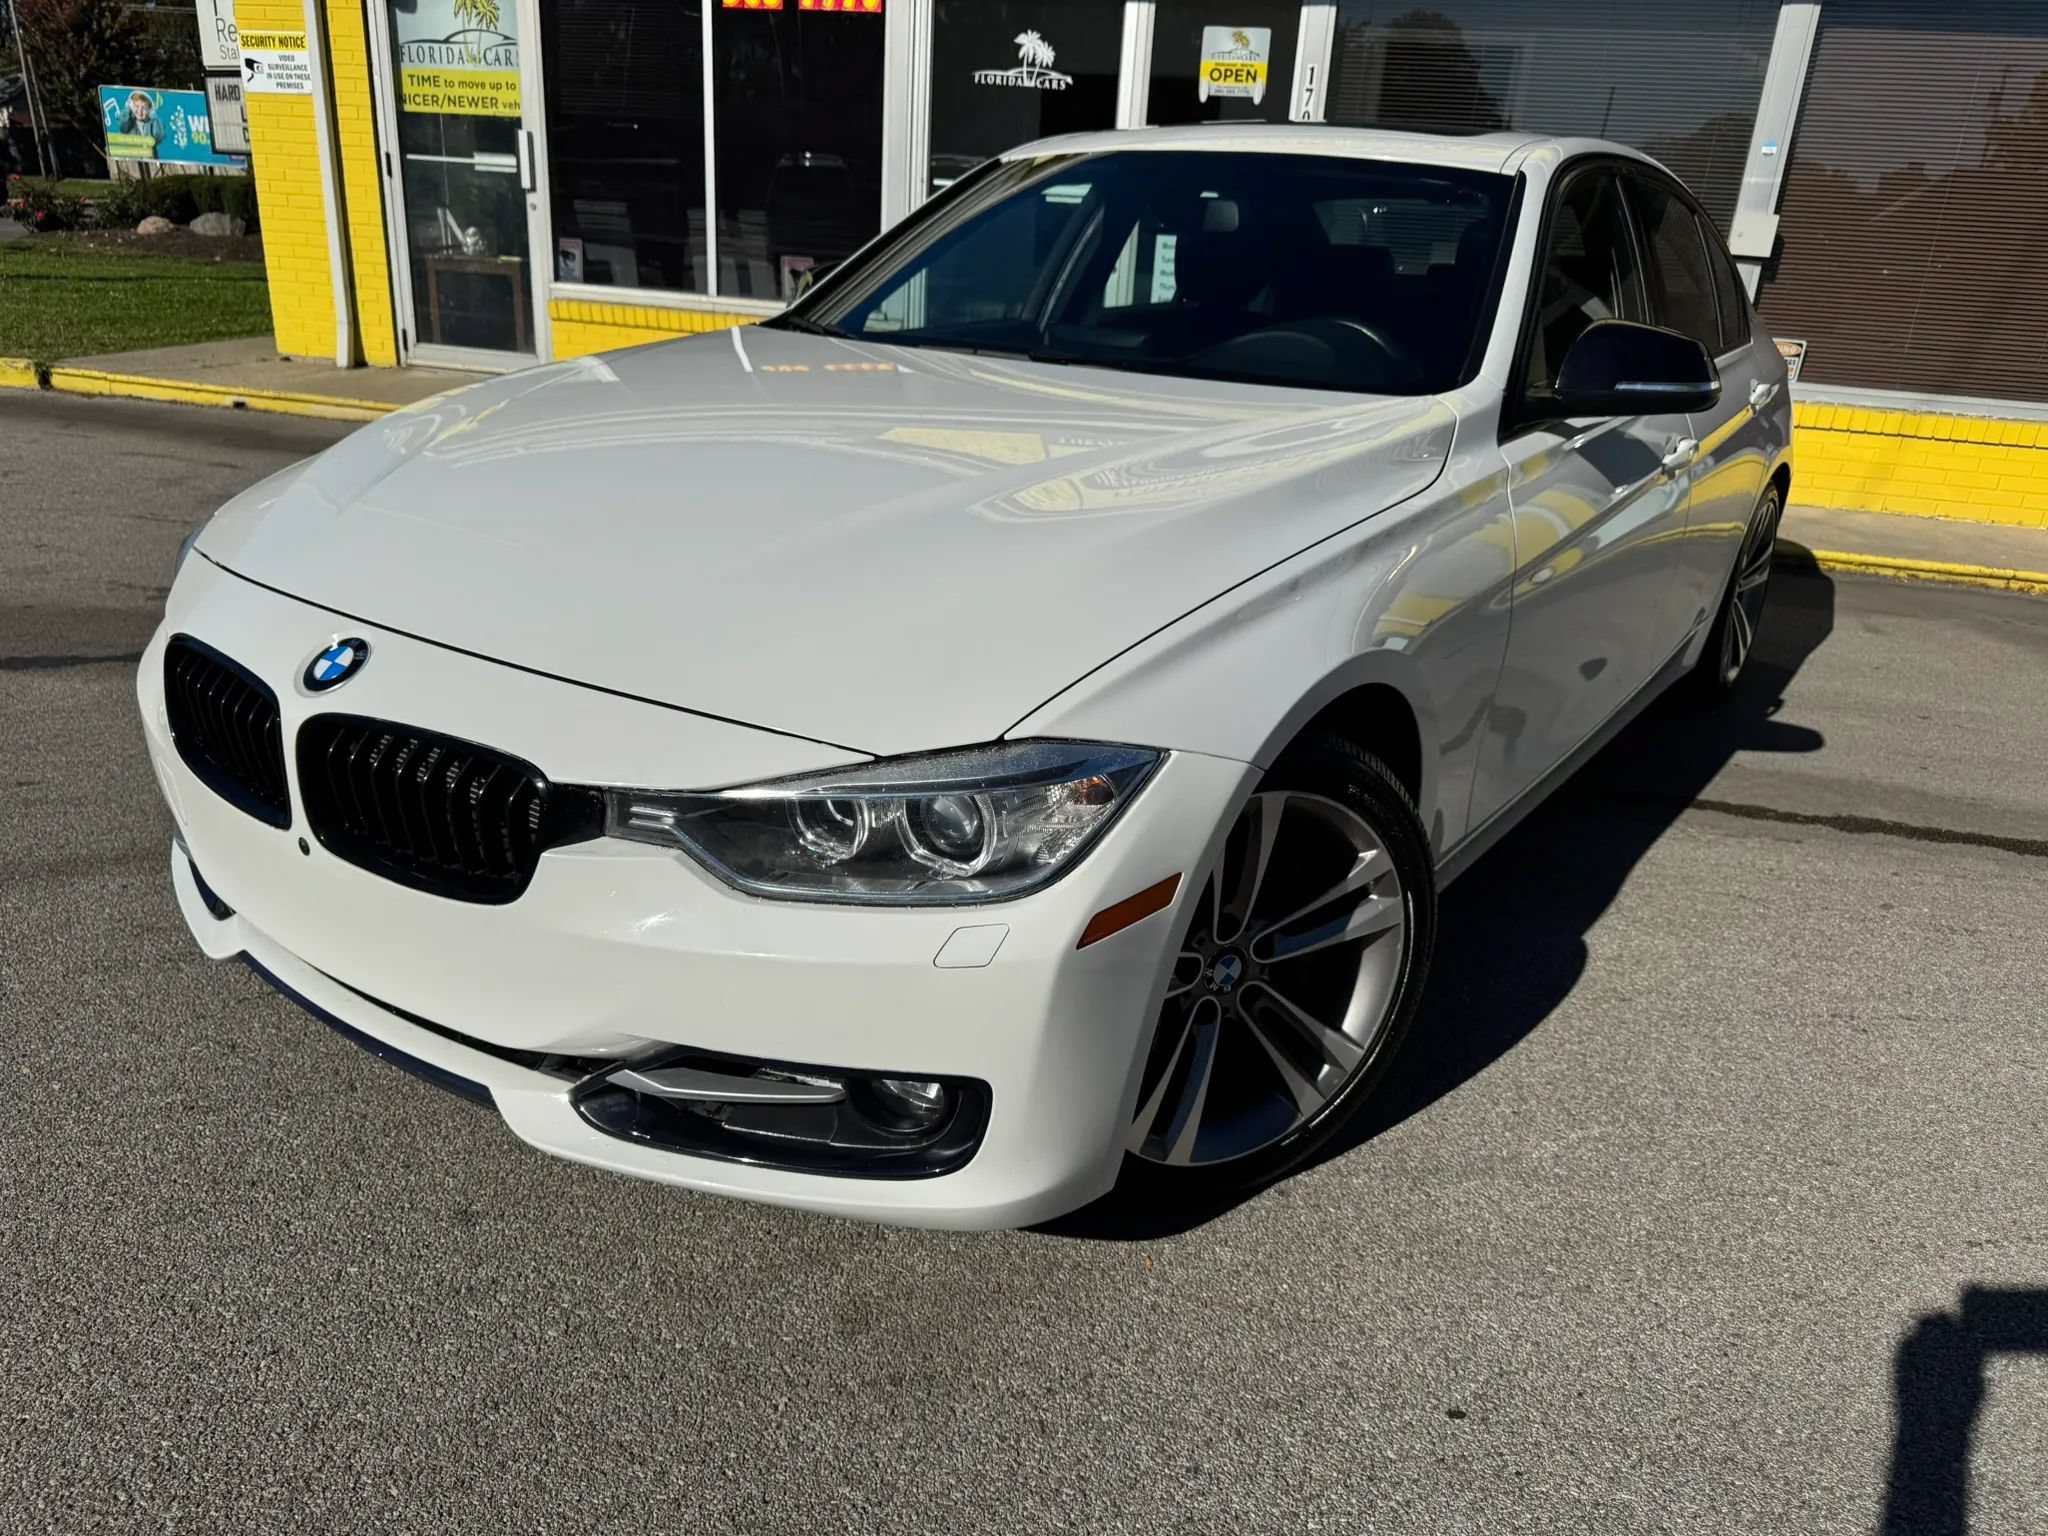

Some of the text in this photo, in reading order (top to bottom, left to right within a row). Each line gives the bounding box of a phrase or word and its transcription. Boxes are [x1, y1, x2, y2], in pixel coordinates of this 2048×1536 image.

[240, 35, 305, 49] SECURITY NOTICE
[279, 54, 295, 62] VIDEO
[400, 45, 465, 65] FLORIDA
[267, 63, 308, 72] SURVEILLANCE
[1209, 67, 1257, 83] OPEN
[295, 73, 311, 81] THESE
[408, 74, 517, 92] TIME to move up to
[974, 73, 1066, 90] FLORIDA CARS
[214, 84, 241, 101] HARD
